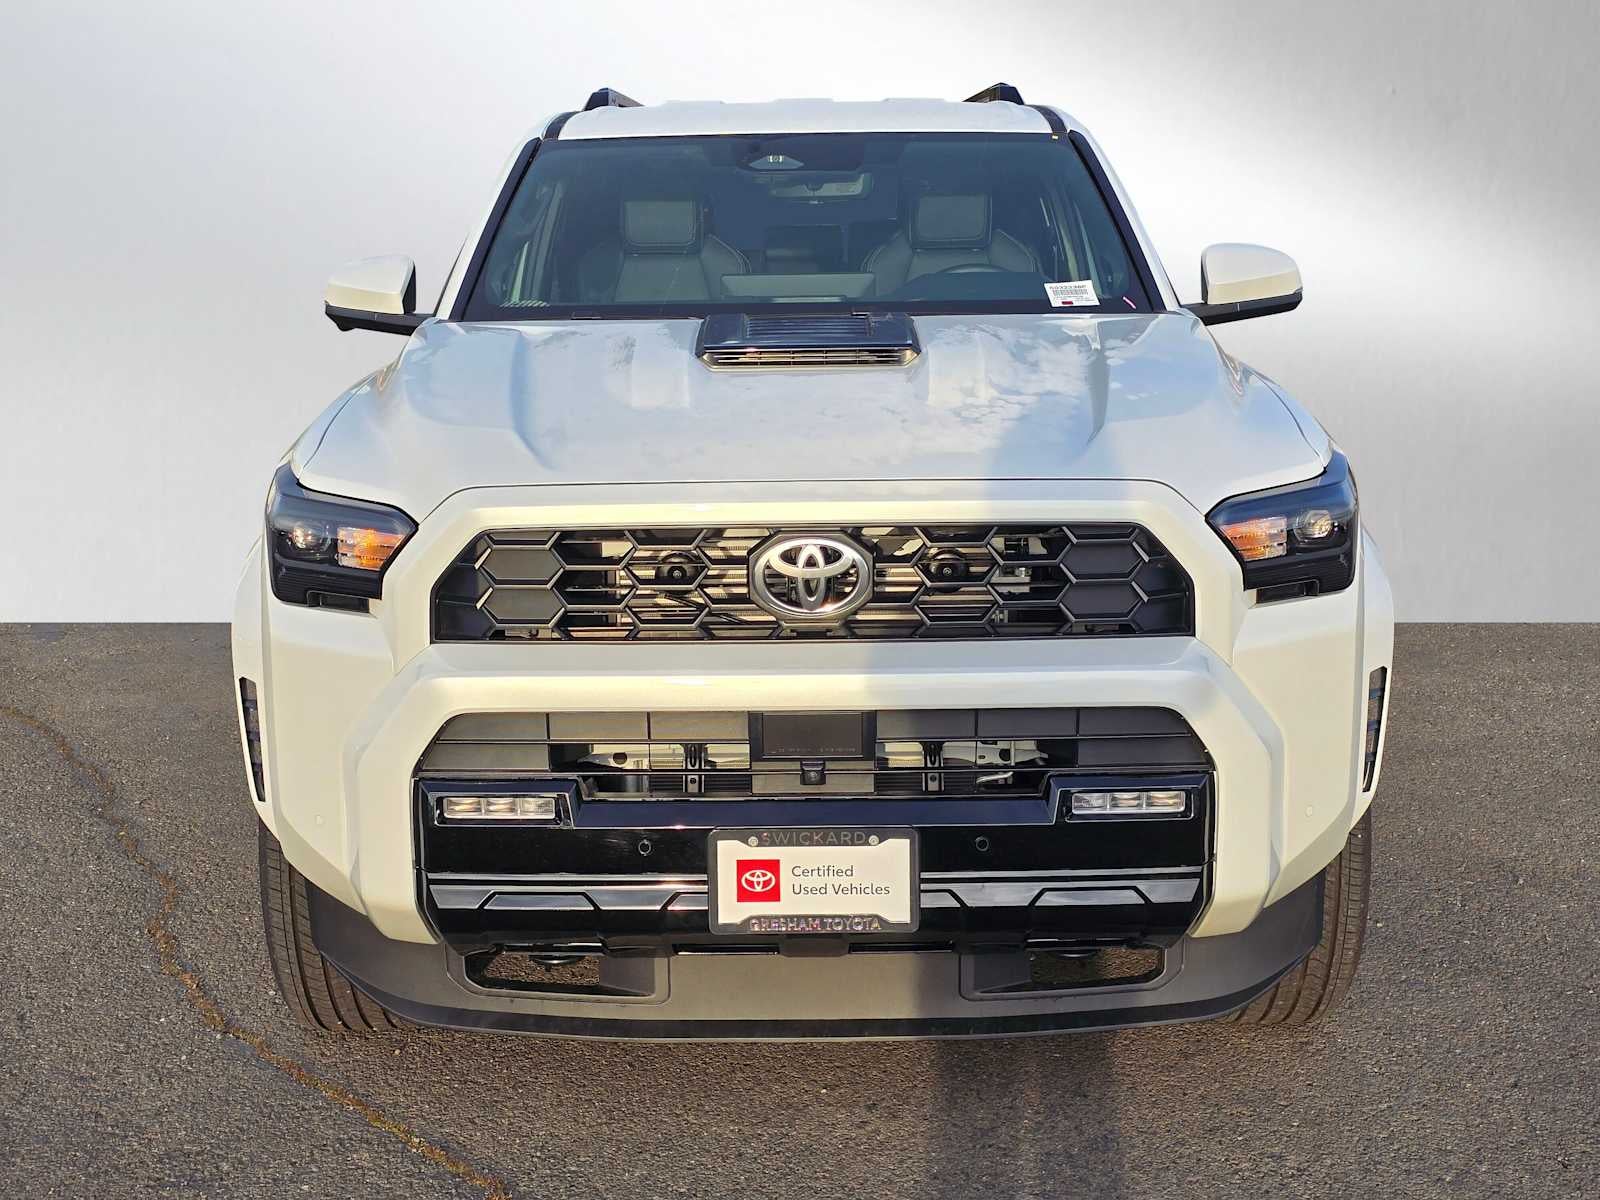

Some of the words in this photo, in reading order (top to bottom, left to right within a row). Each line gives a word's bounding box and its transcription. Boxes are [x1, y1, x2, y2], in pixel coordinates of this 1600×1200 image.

[760, 831, 867, 845] SWICKARD
[791, 864, 854, 878] Certified
[791, 884, 828, 896] Used
[831, 883, 891, 896] Vehicles
[751, 918, 821, 932] GRESHAM
[823, 917, 882, 931] TOYOTA
